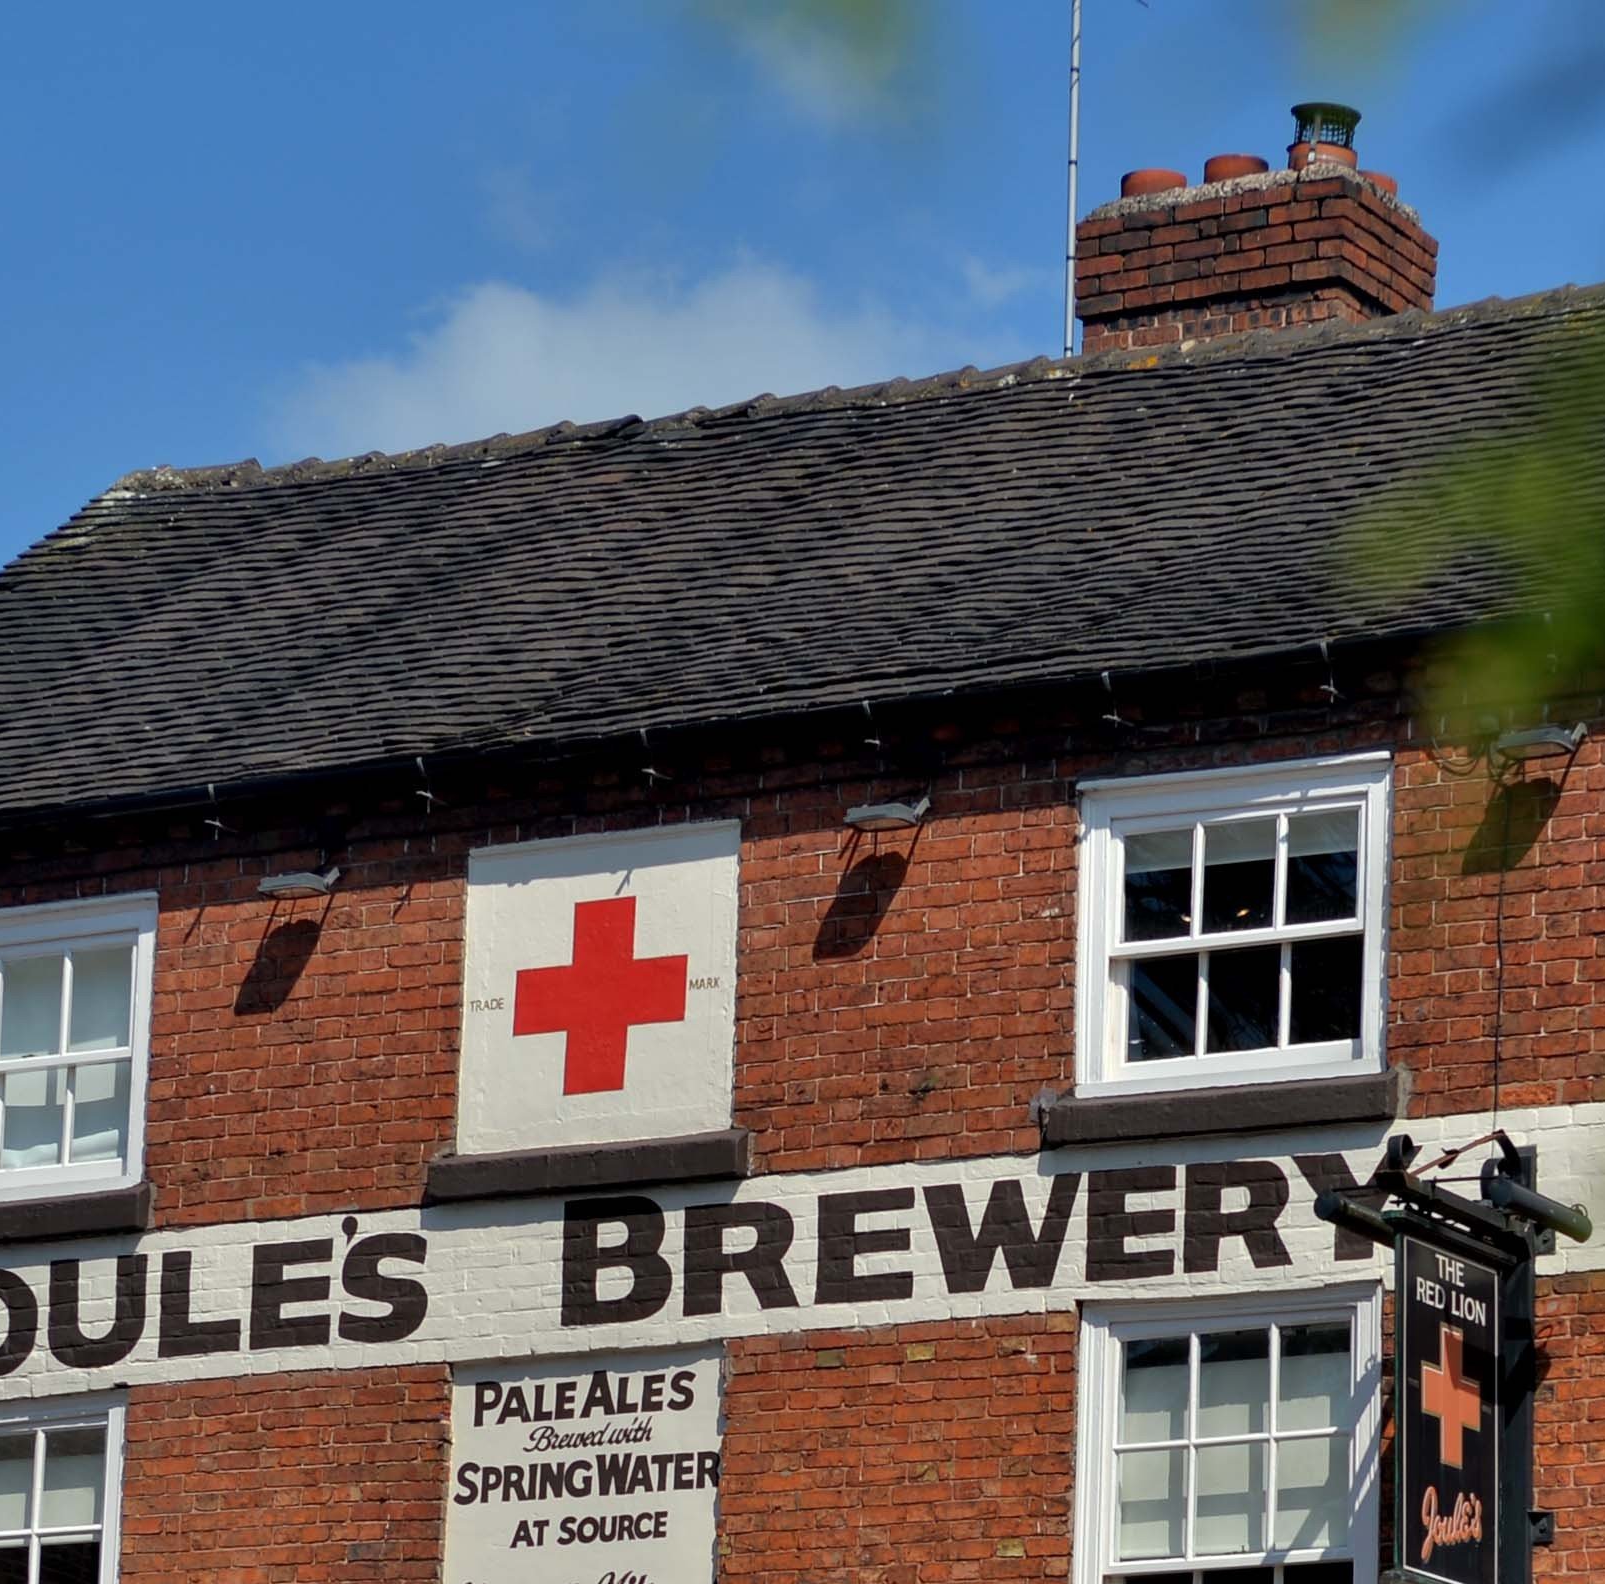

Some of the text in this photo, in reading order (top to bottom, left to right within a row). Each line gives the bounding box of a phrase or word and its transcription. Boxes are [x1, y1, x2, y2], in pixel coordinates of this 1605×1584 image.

[469, 976, 721, 1014] TRADE MARK
[561, 1153, 1422, 1327] BREWERY
[1435, 1253, 1466, 1289] THE
[1415, 1276, 1487, 1328] RED LION
[473, 1369, 696, 1427] PALE ALES
[523, 1416, 653, 1453] Brewed with
[453, 1451, 720, 1505] SPRING WATER
[510, 1510, 668, 1549] AT SOURCE
